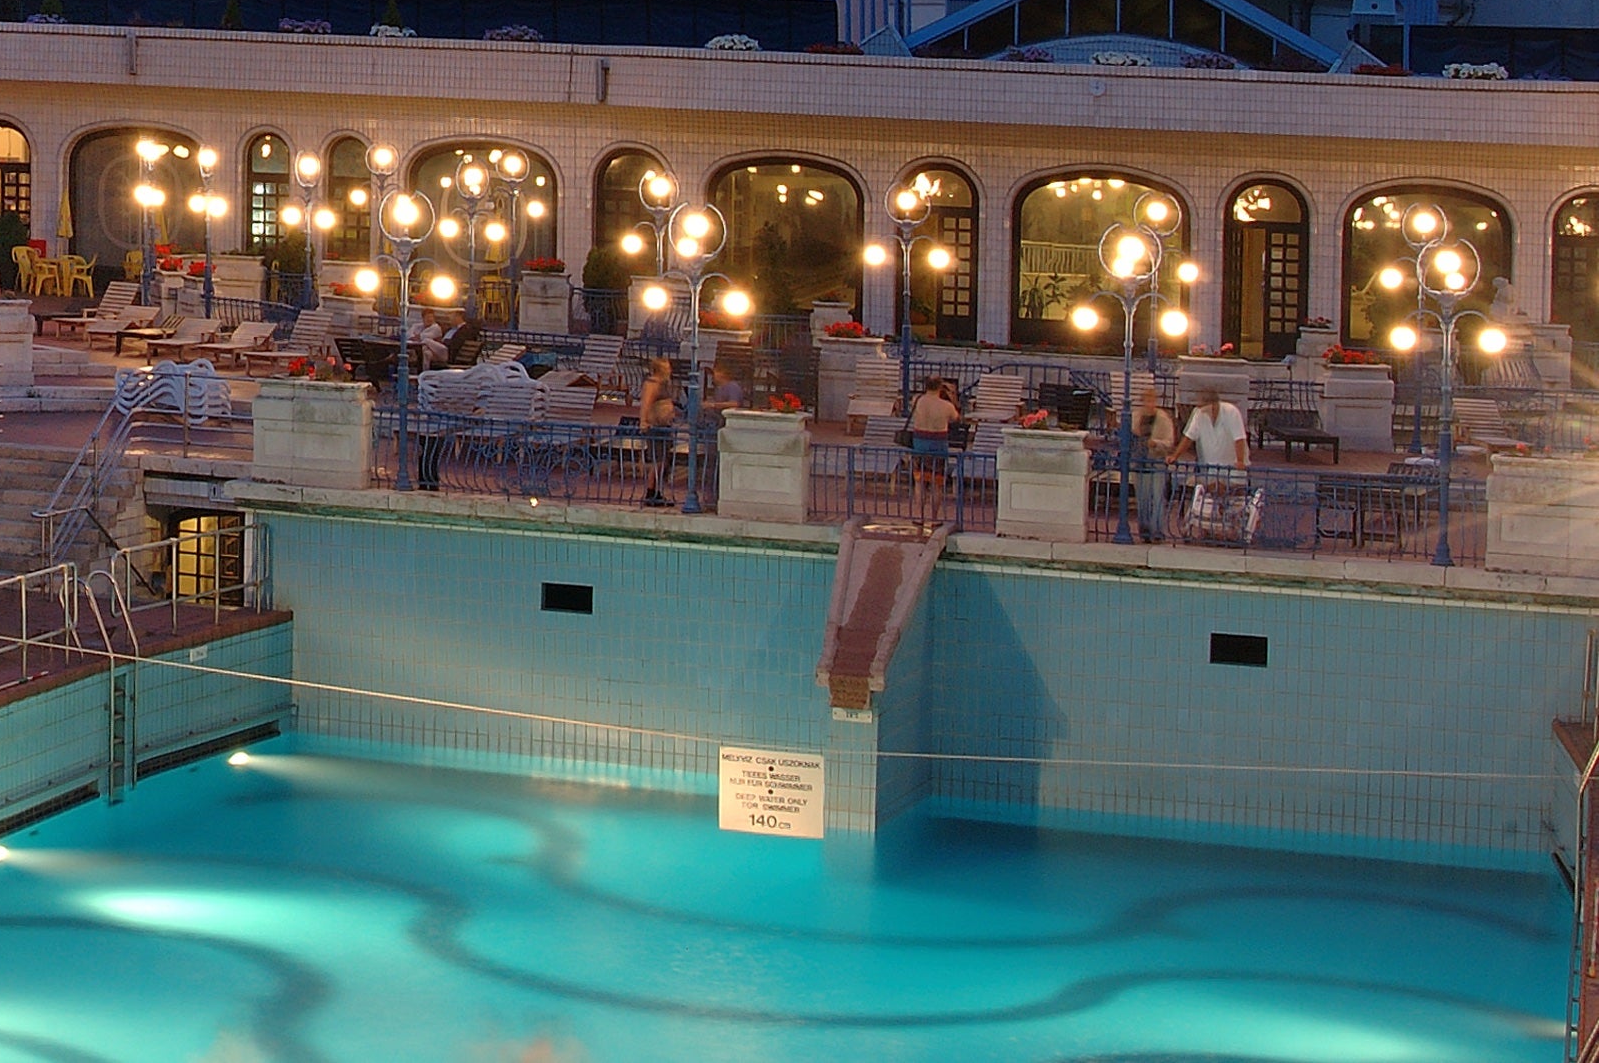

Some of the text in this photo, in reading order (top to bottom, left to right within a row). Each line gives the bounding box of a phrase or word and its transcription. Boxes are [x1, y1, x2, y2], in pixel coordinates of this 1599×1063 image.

[758, 795, 785, 804] WATER
[787, 797, 808, 806] ONLY
[749, 814, 777, 828] 140
